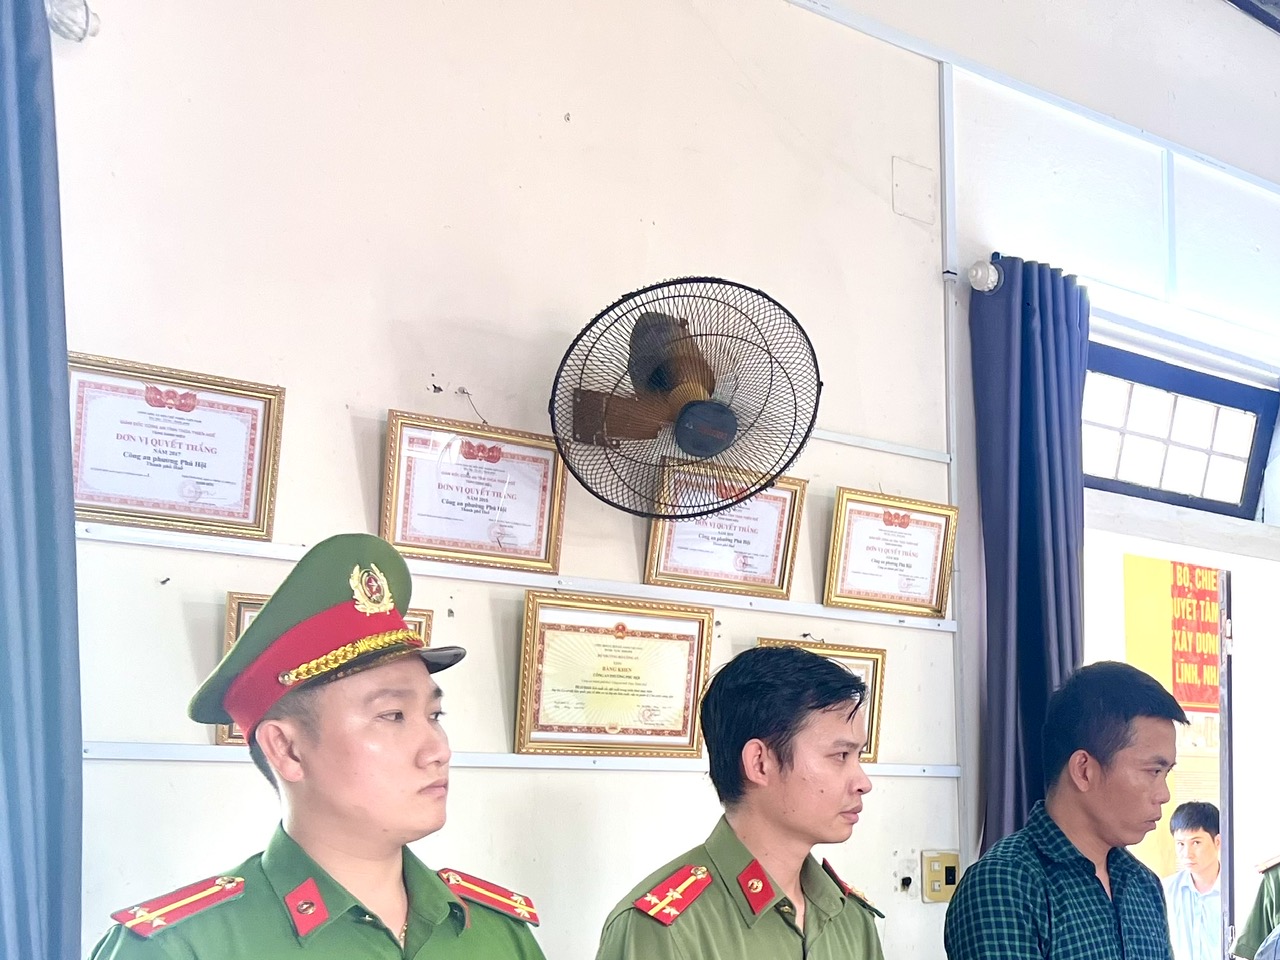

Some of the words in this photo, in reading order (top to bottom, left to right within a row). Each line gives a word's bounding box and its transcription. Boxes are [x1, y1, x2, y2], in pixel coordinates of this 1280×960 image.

[116, 432, 136, 442] ĐƠN
[140, 436, 148, 445] VỊ
[150, 437, 183, 450] QUYẾT
[185, 441, 218, 455] THẮNG
[122, 451, 141, 461] Công
[492, 490, 517, 500] THNG
[716, 521, 737, 531] QUYẾT
[738, 525, 758, 534] THẮNG
[1172, 592, 1197, 620] UYẾT
[1174, 626, 1193, 652] XÂY
[1203, 664, 1219, 687] NH
